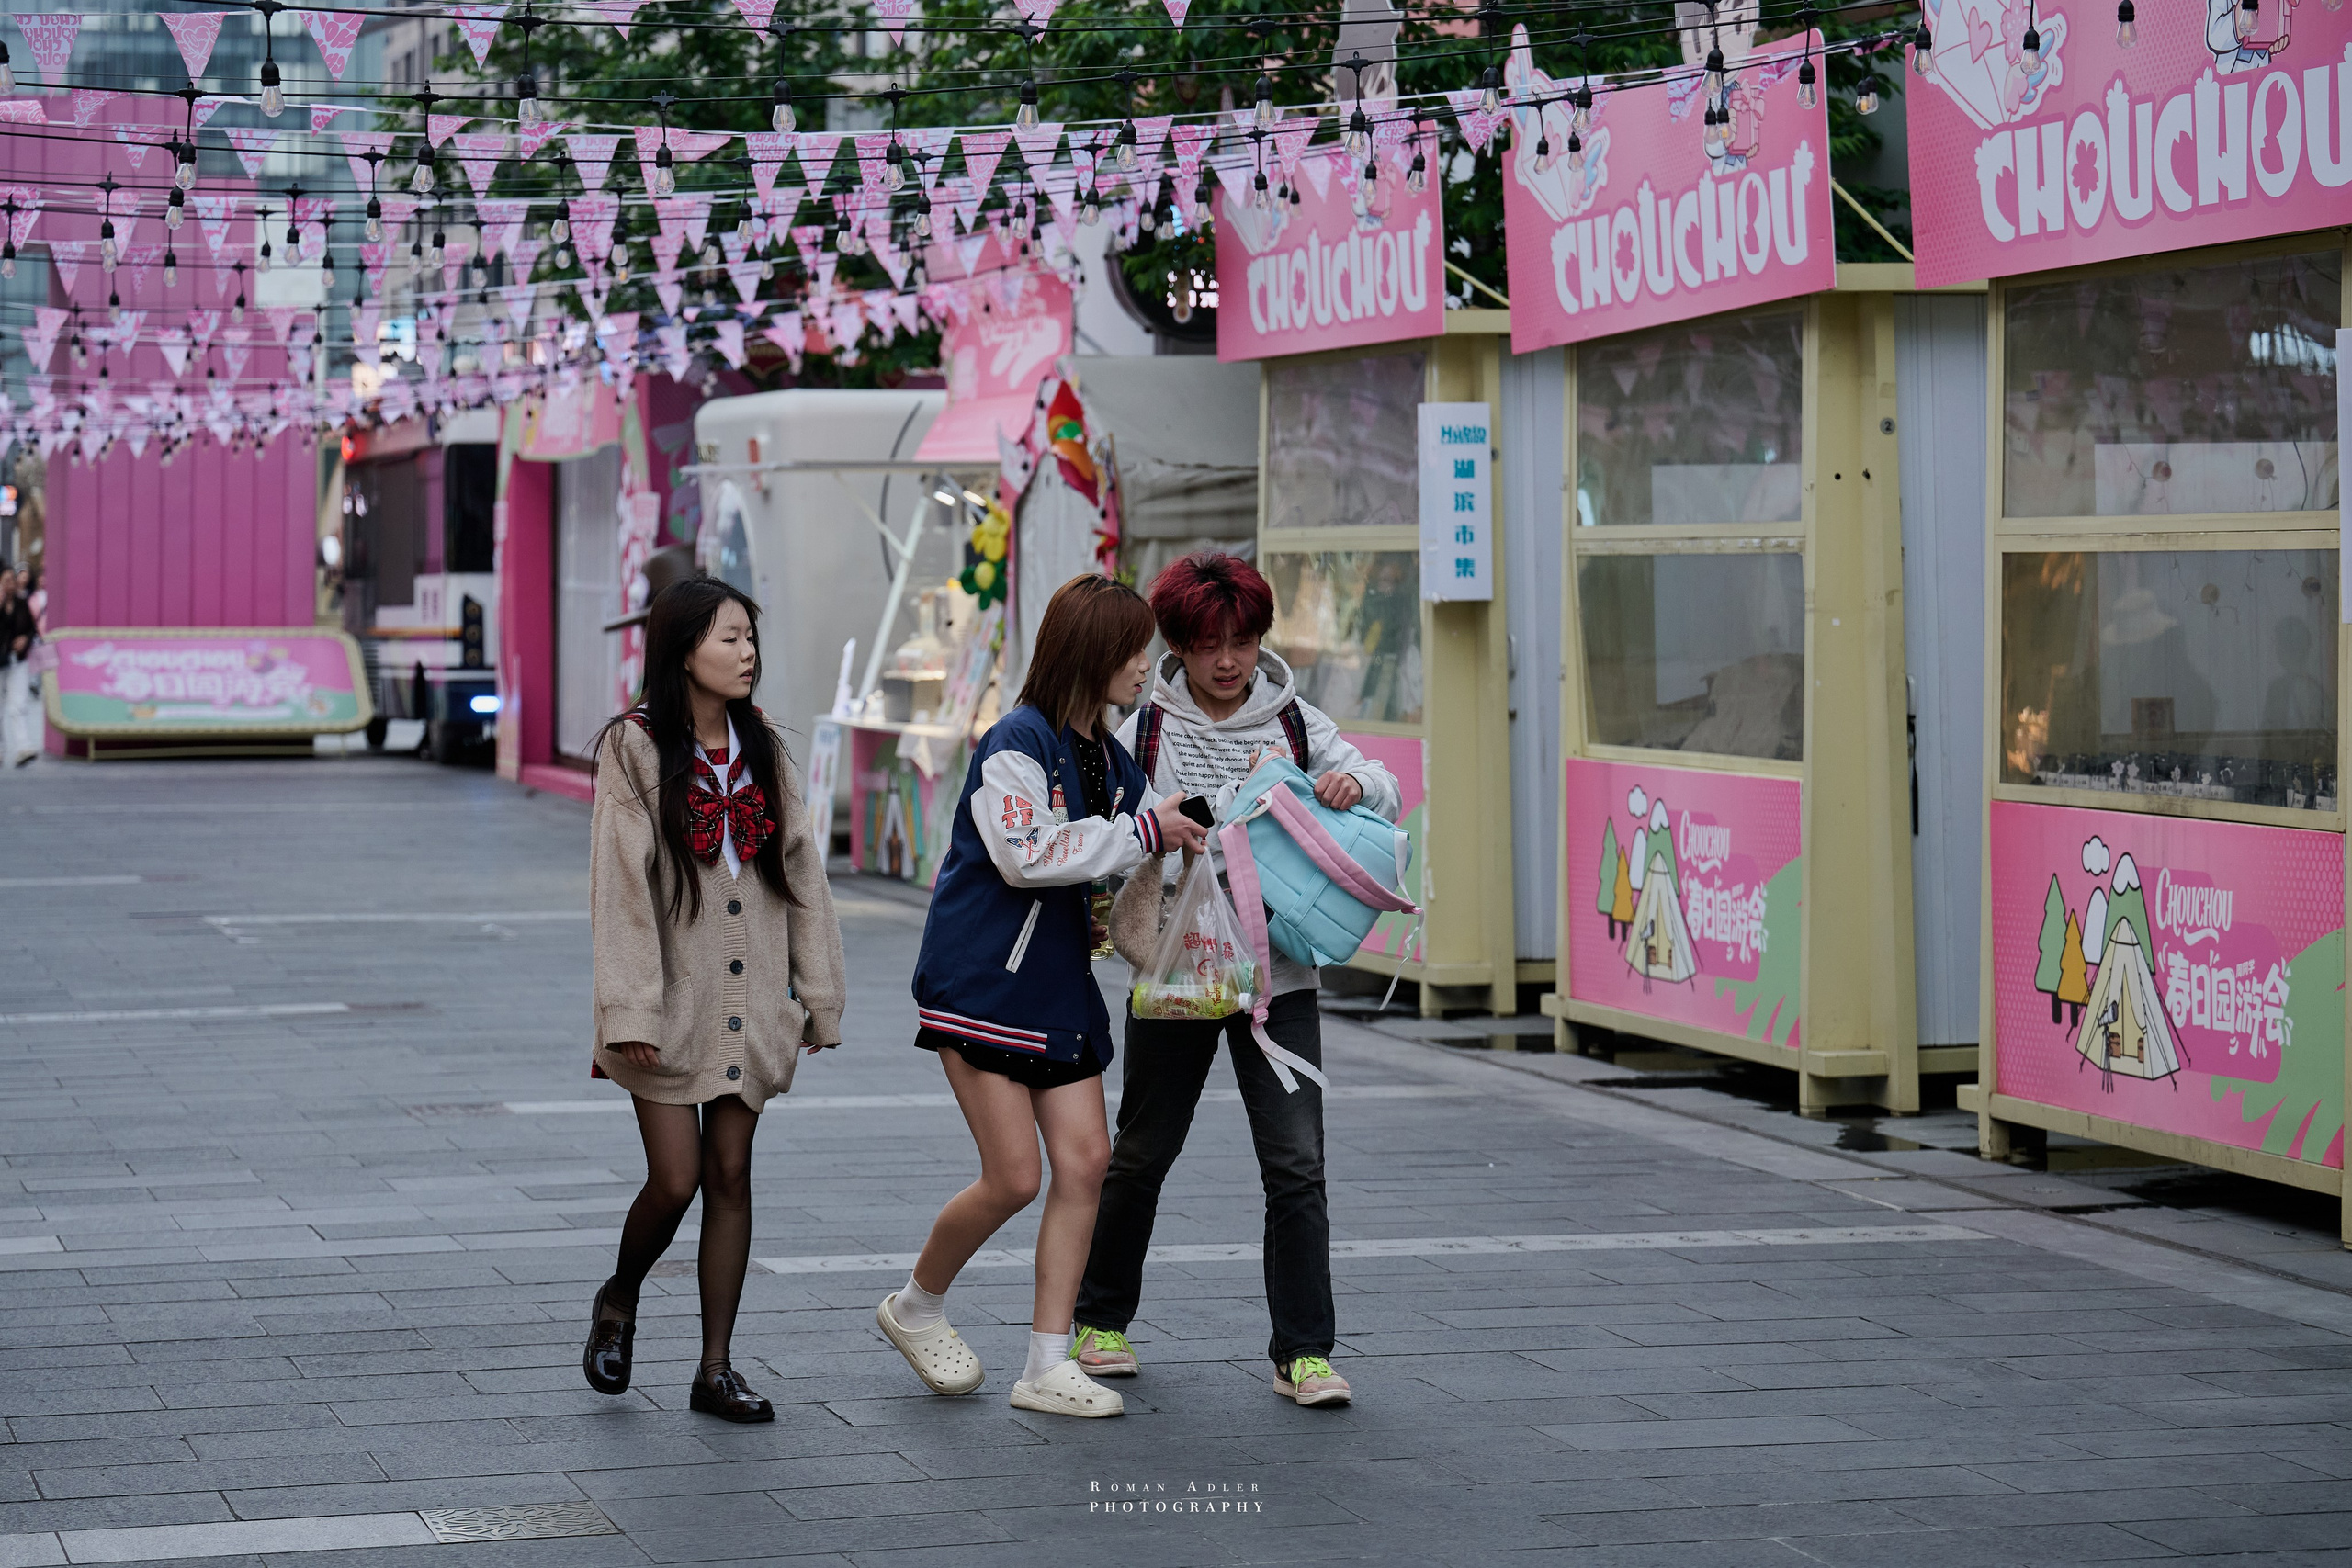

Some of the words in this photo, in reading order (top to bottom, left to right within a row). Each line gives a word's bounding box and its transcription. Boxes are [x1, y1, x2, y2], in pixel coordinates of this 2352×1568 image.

[1974, 42, 2352, 243] CHOUCHOU
[1246, 209, 1432, 334] CHOUCHOU
[1549, 140, 1815, 315] CHOUCHOU
[1453, 459, 1476, 579] 湖滨市集
[1679, 810, 1730, 867] CHOUCHOU
[1685, 880, 1768, 961] 春日园游会
[2155, 867, 2233, 937] CHOUCHOU
[2163, 950, 2293, 1058] 春日园游会
